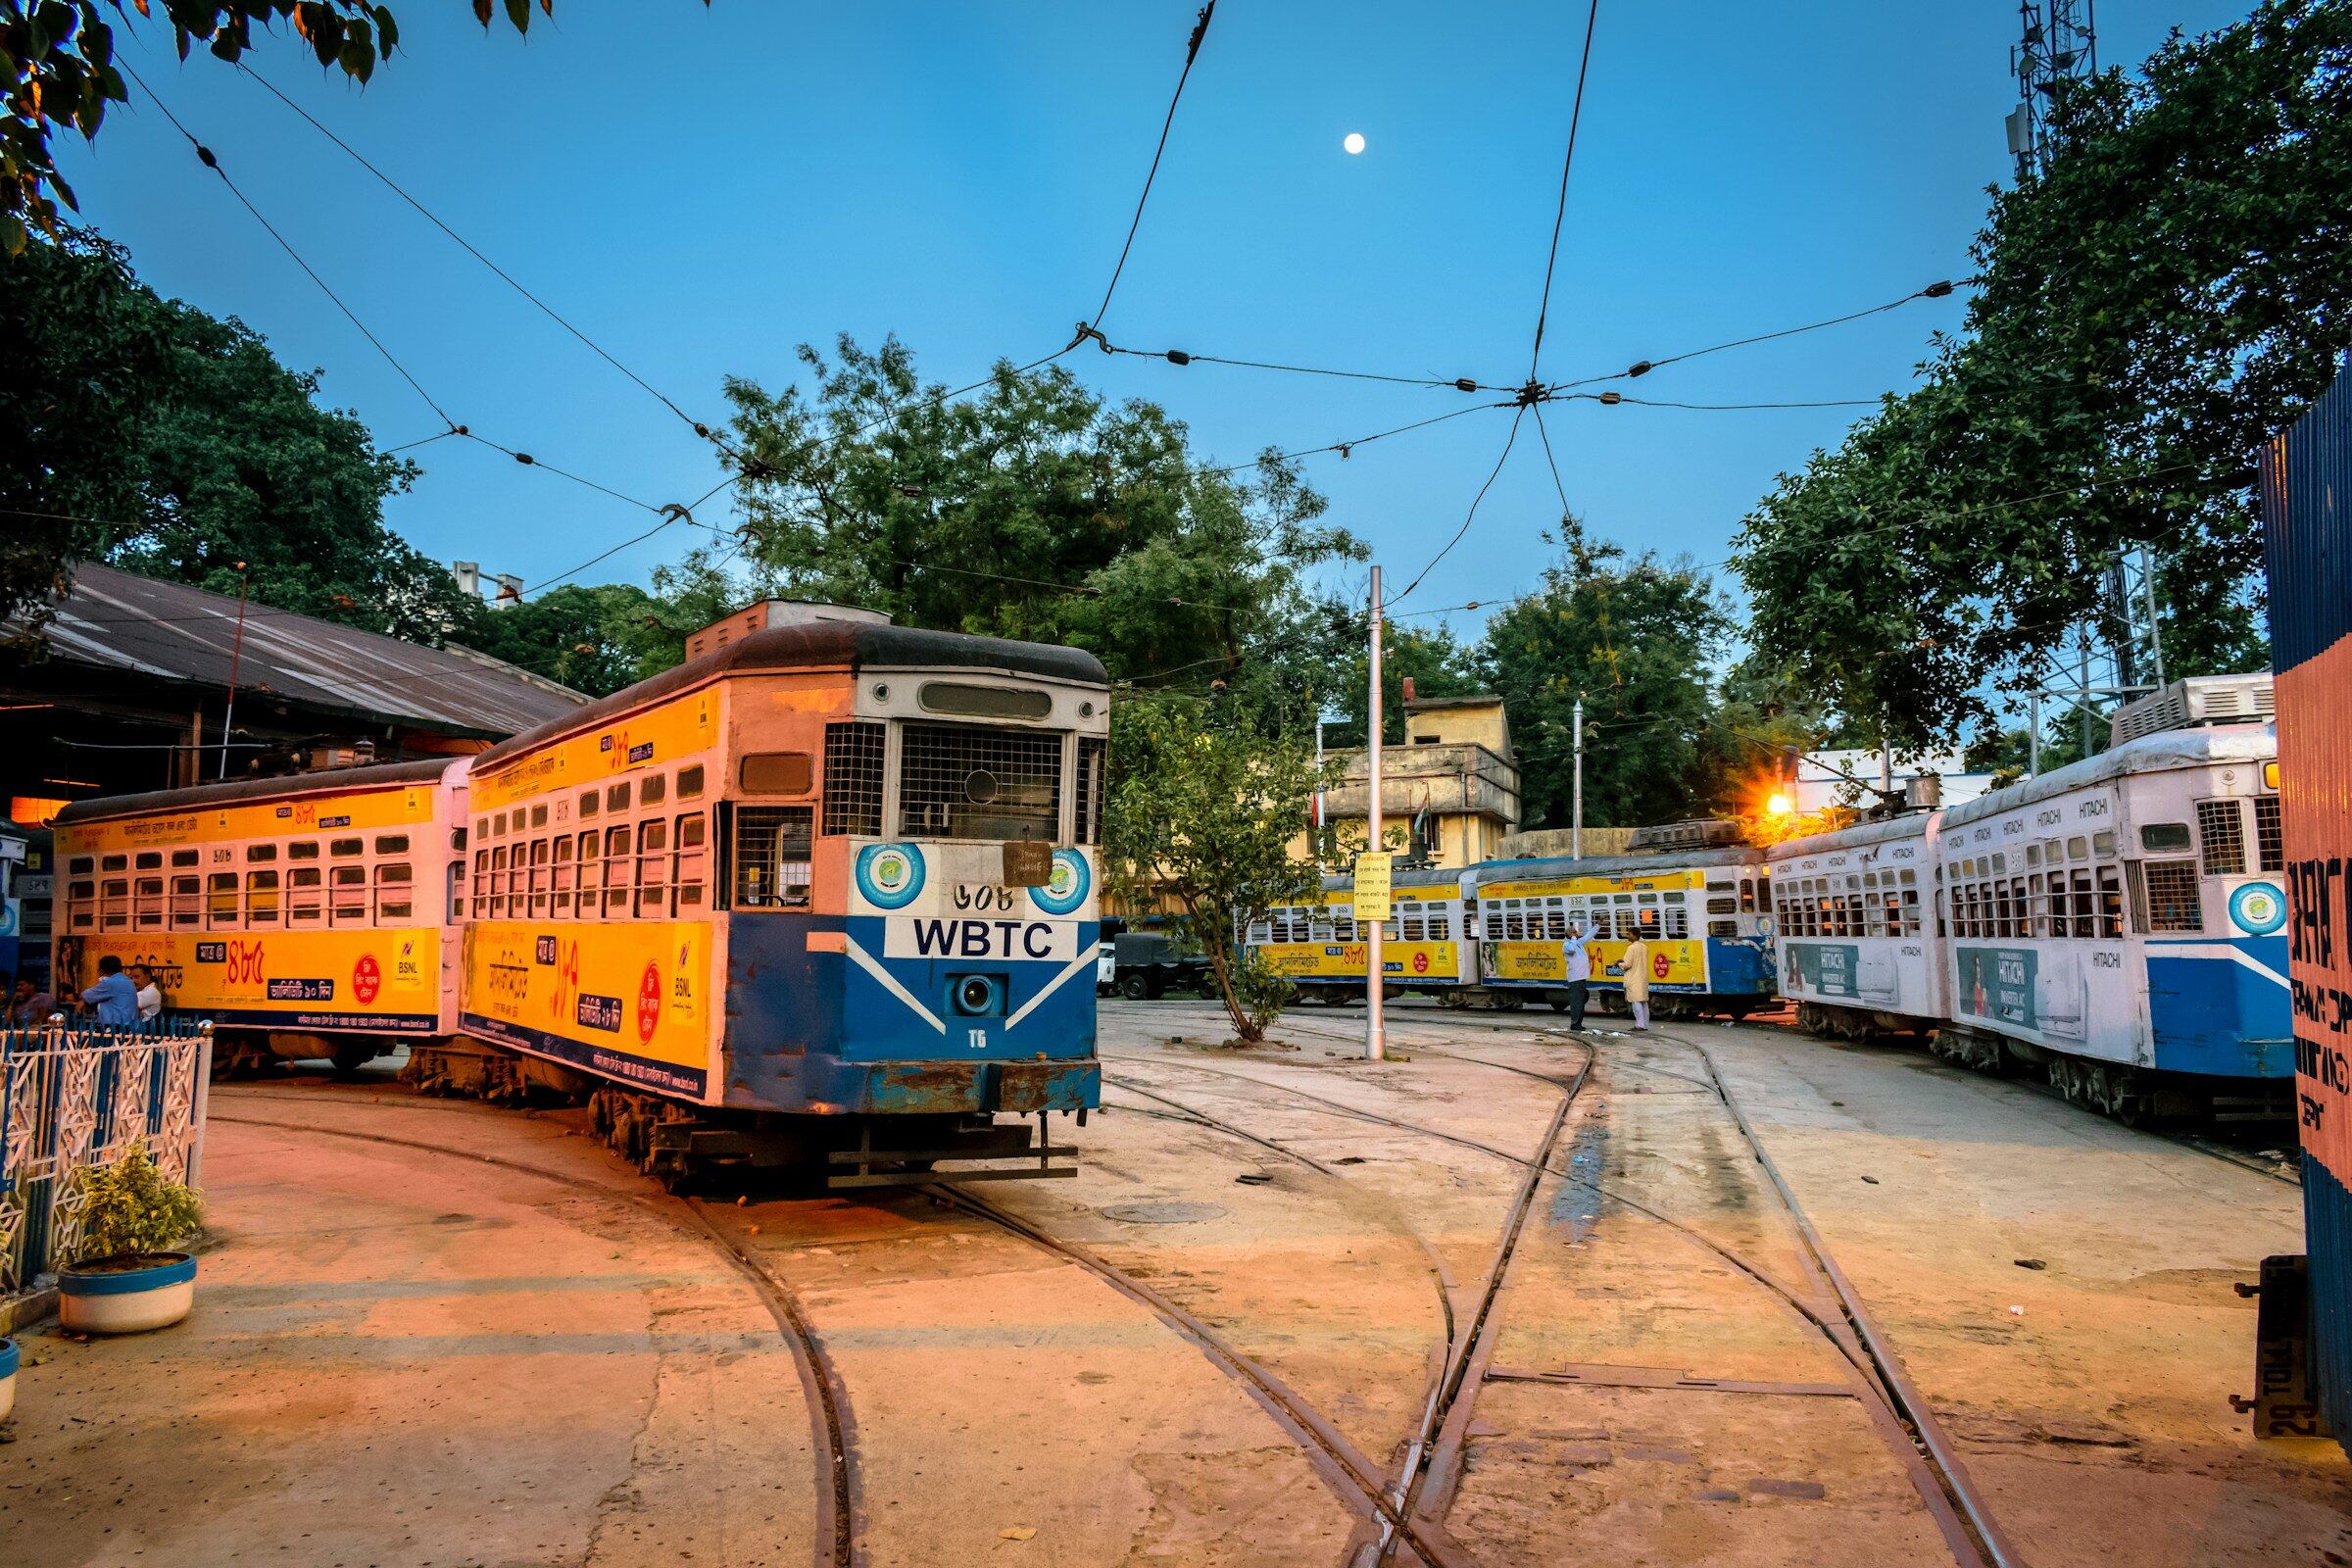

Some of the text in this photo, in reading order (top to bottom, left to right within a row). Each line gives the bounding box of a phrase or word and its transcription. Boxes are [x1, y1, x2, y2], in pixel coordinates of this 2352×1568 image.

[2080, 798, 2108, 818] HITACHI
[2037, 808, 2061, 827] HITACHI
[1975, 826, 1991, 843] HITACHI
[2003, 818, 2024, 836] HITACHI
[1948, 835, 1964, 851] HITACHI
[1892, 848, 1914, 858] HITACHI
[913, 918, 1054, 958] WBTC
[1901, 946, 1922, 956] HITACHI
[2092, 952, 2121, 968] HITACHI
[228, 940, 265, 985] ৪৮৫
[399, 962, 417, 974] BSNL
[1821, 953, 1845, 969] HITACHI
[1998, 959, 2025, 985] HITACHI
[675, 977, 691, 998] BSNL
[2269, 1404, 2320, 1436] 29
